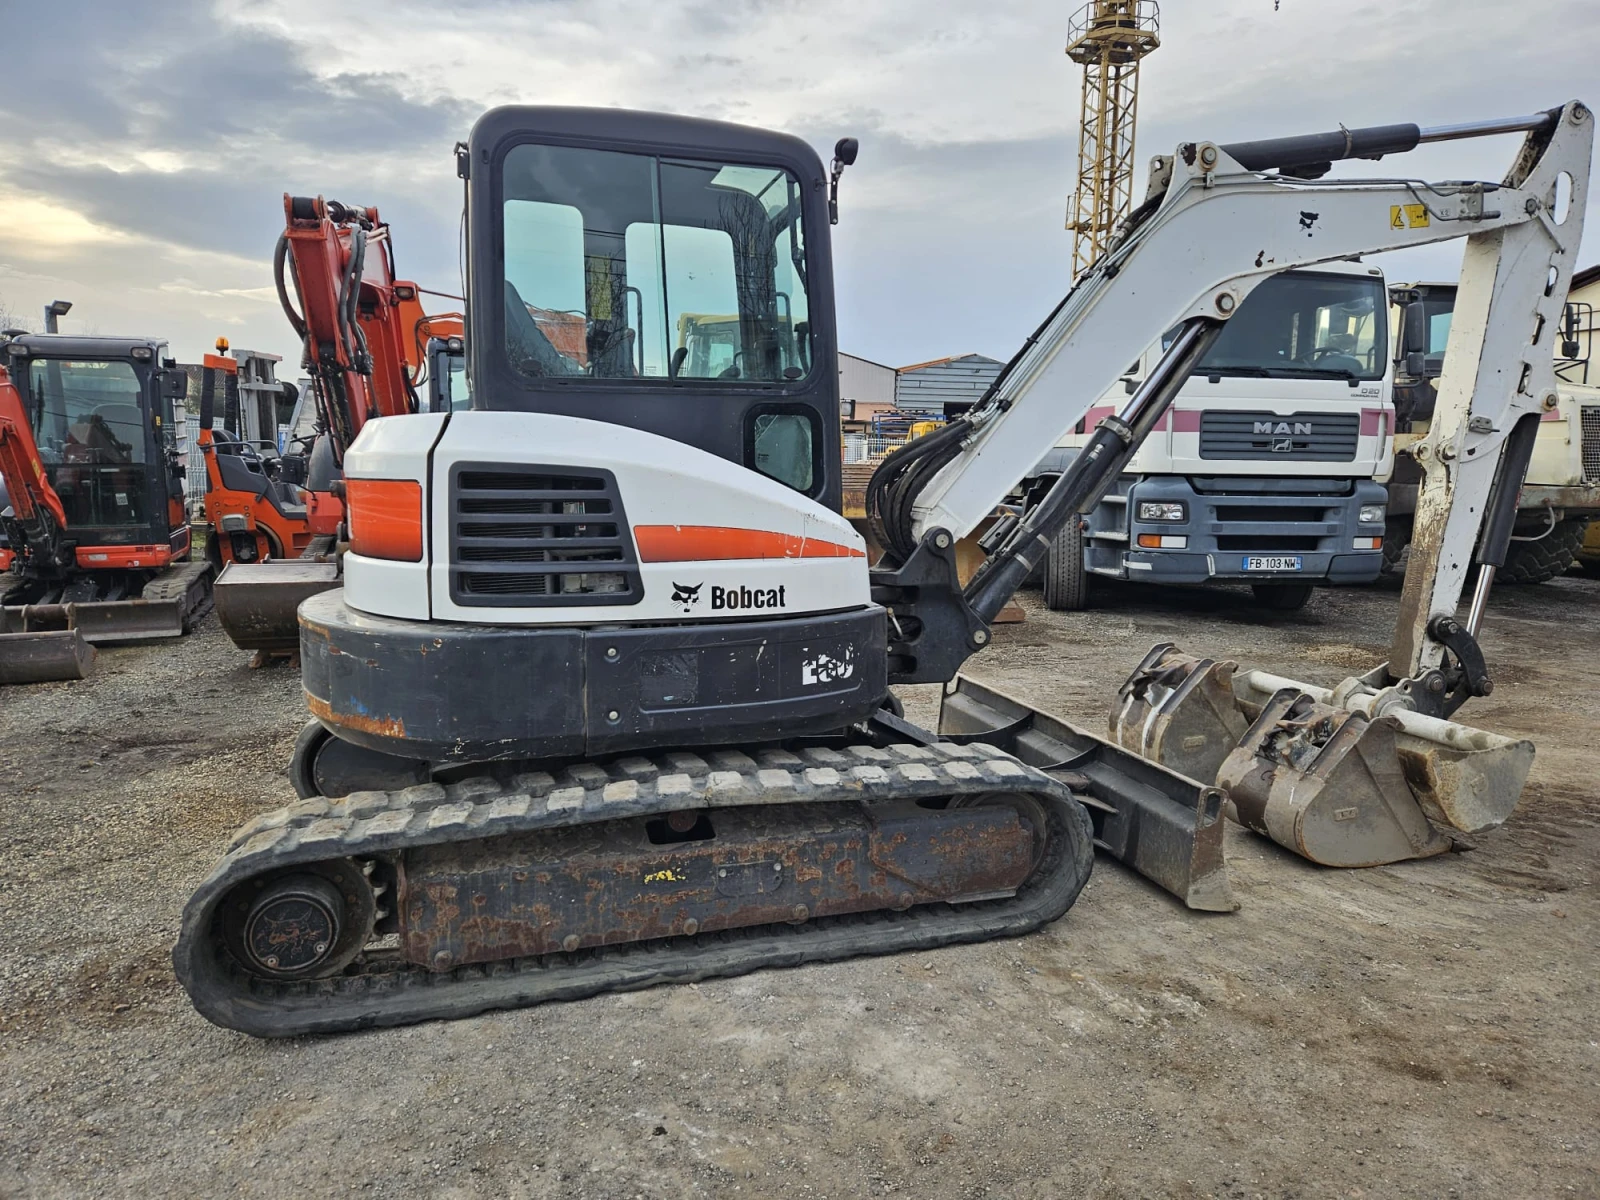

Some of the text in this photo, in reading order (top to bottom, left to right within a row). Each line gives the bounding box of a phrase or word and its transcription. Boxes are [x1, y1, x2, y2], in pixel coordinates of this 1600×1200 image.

[1253, 422, 1312, 434] MAN
[1249, 558, 1296, 569] FB-103-NW
[711, 585, 786, 609] Bobcat
